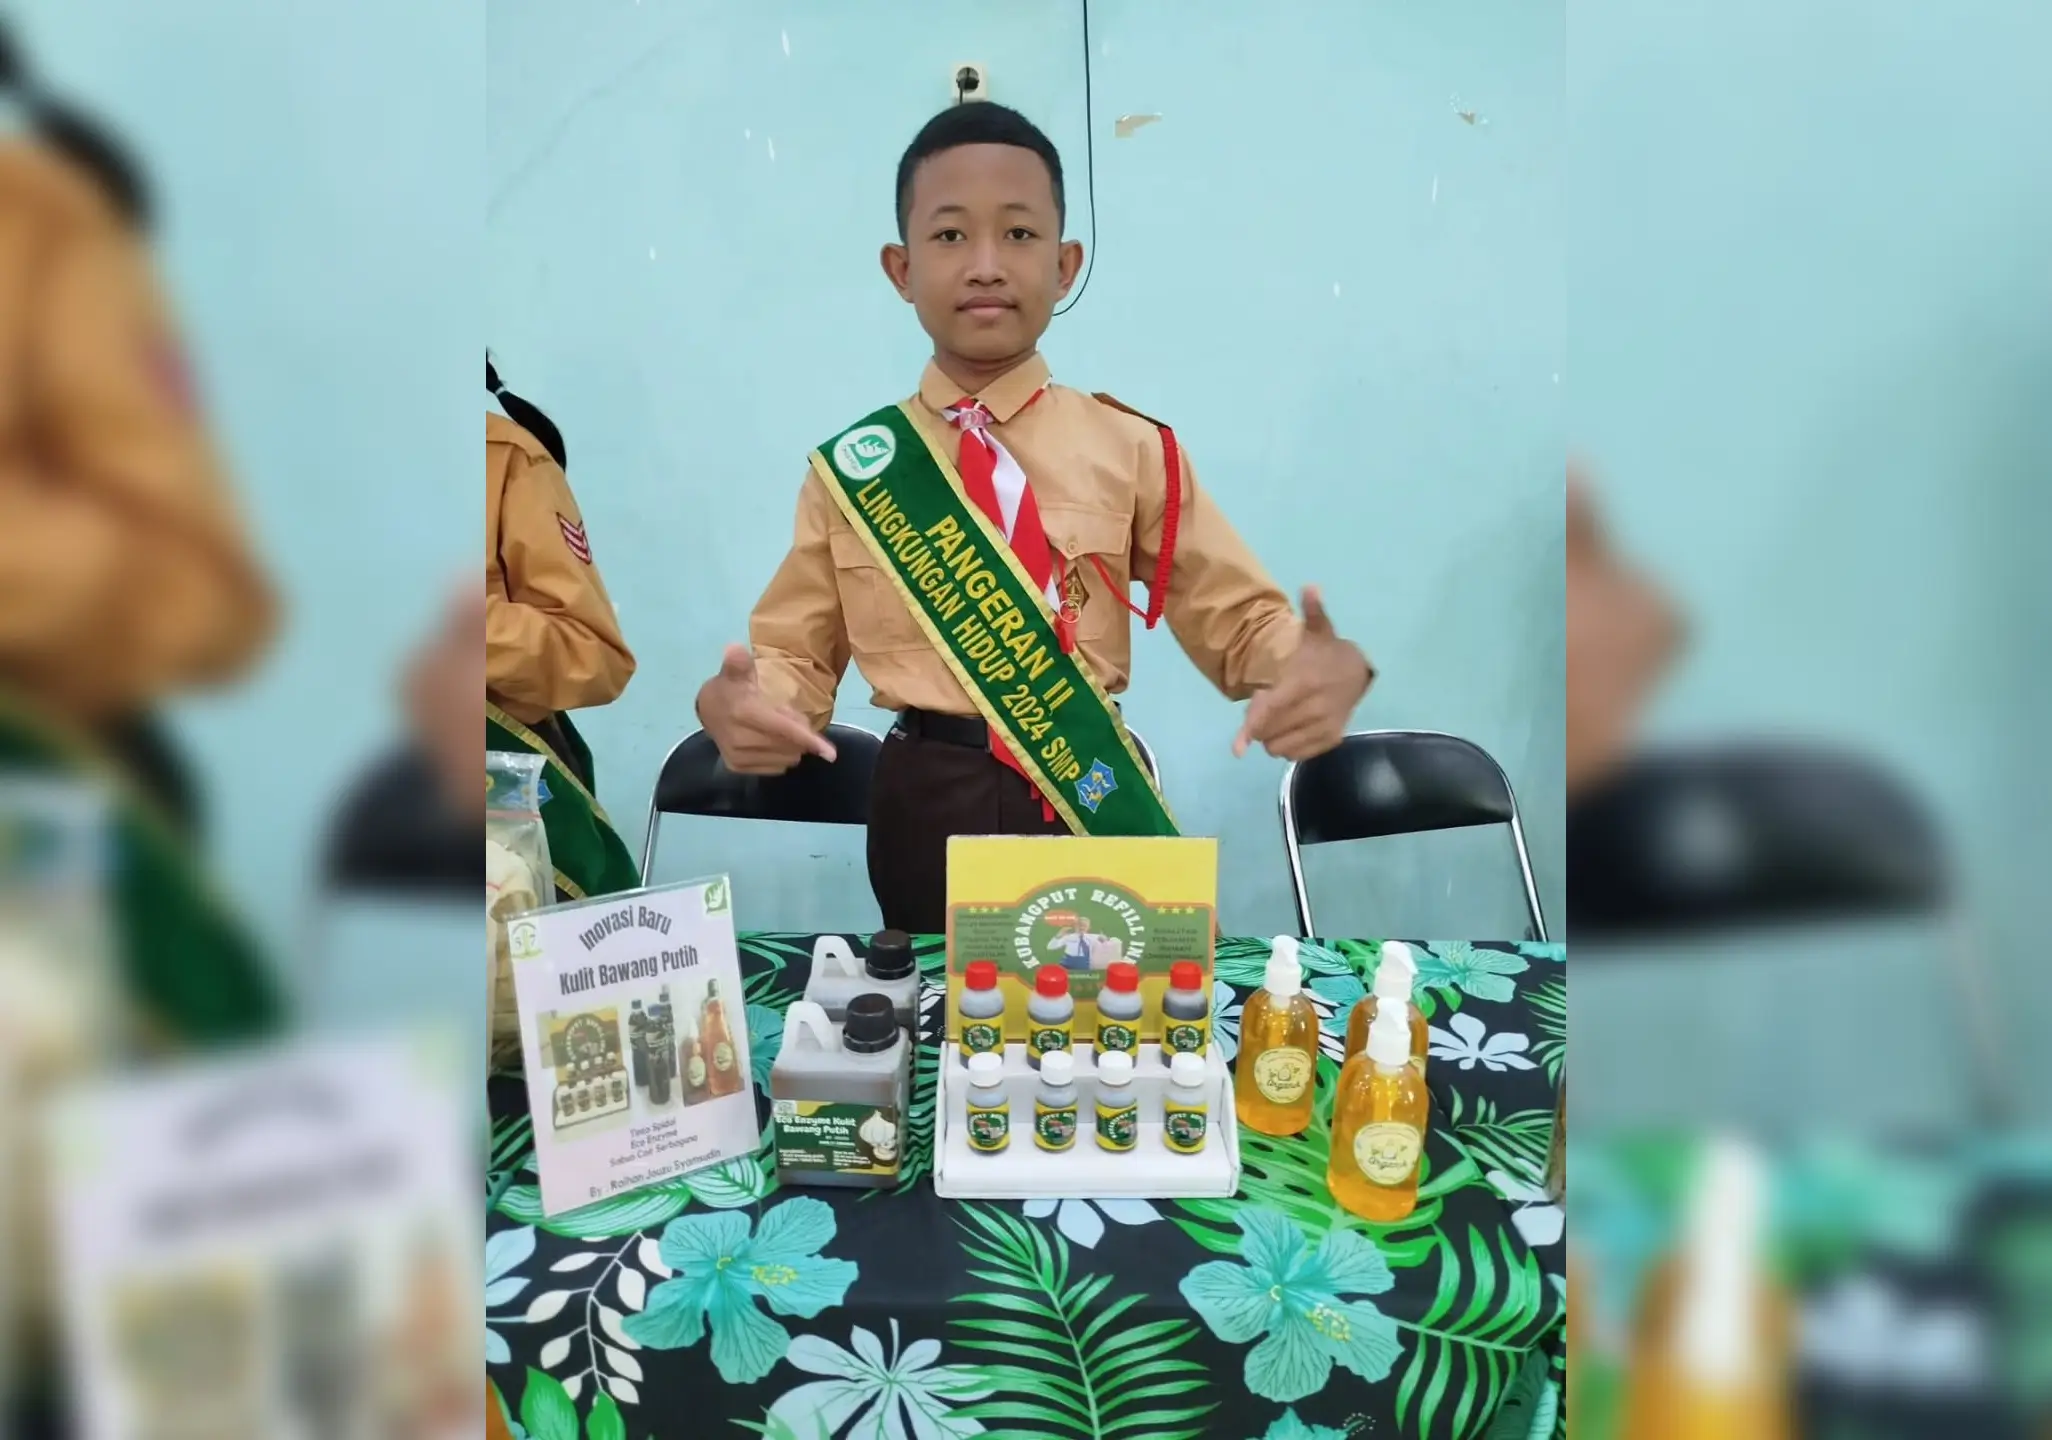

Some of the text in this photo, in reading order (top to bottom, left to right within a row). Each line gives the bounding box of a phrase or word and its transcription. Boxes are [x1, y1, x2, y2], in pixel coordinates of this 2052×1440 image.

[856, 478, 1081, 782] LINGKUNGAN HIDUP 2024 SMP
[925, 514, 1075, 711] PANGERAN II
[579, 905, 672, 952] Inovasi Baru
[1091, 889, 1145, 936] REFILL
[559, 945, 699, 995] Kulit Bawang Putih
[631, 1138, 645, 1149] Eco
[784, 1125, 849, 1136] Bawang Putih
[795, 1116, 831, 1126] Enzyme
[833, 1117, 857, 1127] Kulit
